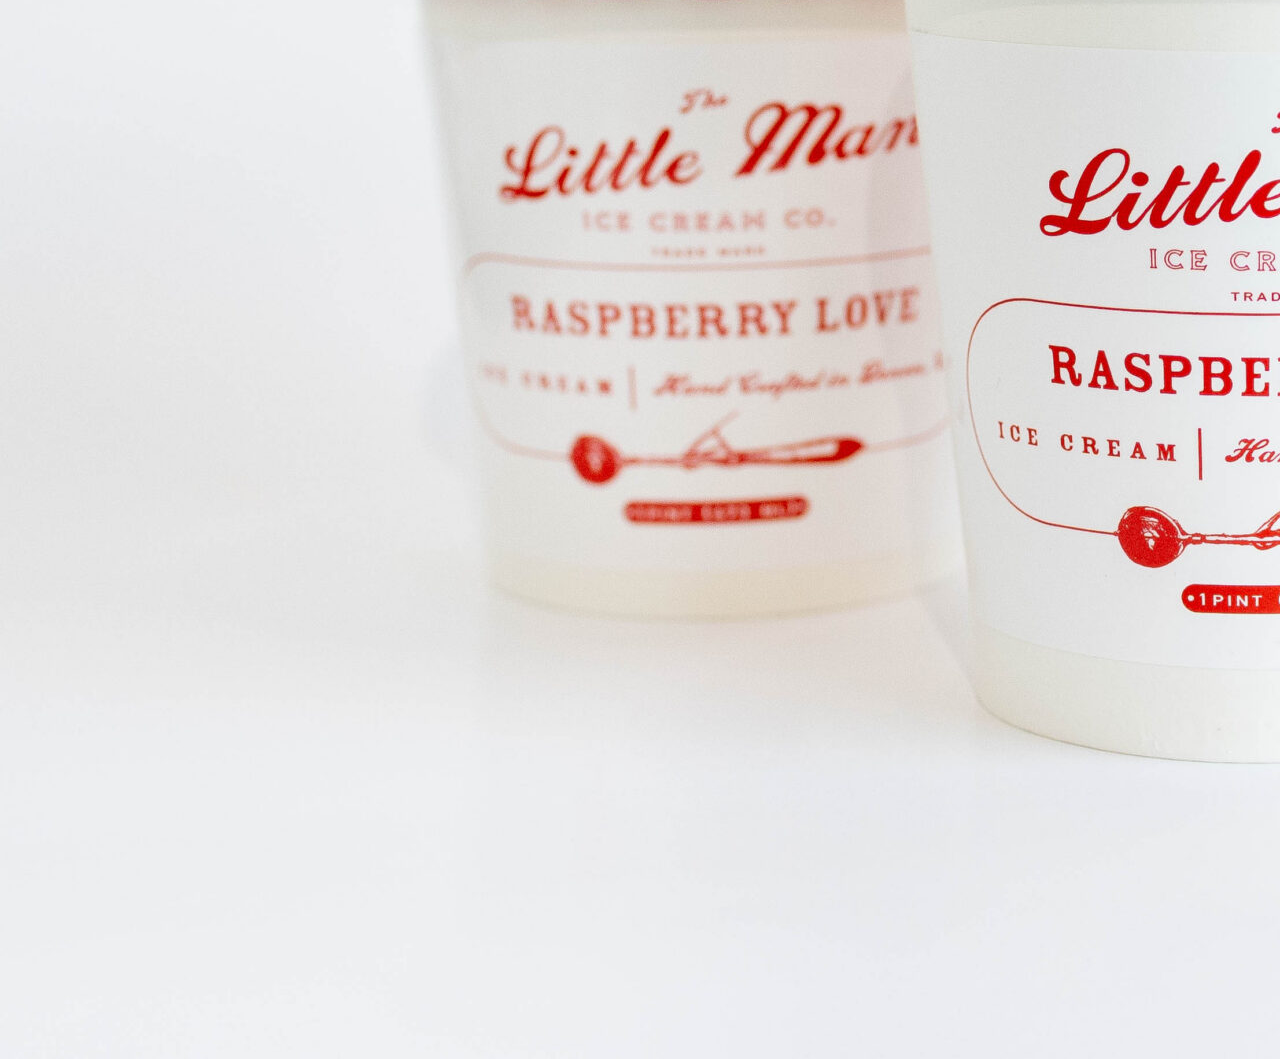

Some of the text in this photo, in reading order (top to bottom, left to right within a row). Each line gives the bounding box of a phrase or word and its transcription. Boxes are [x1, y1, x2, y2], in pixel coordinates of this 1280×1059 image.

[500, 102, 919, 202] Little Man
[583, 211, 631, 233] ICE
[650, 211, 766, 233] CREAM
[1149, 247, 1208, 271] ICE
[511, 287, 920, 340] RASPBERRY LOVE
[998, 420, 1177, 463] ICE CREAM
